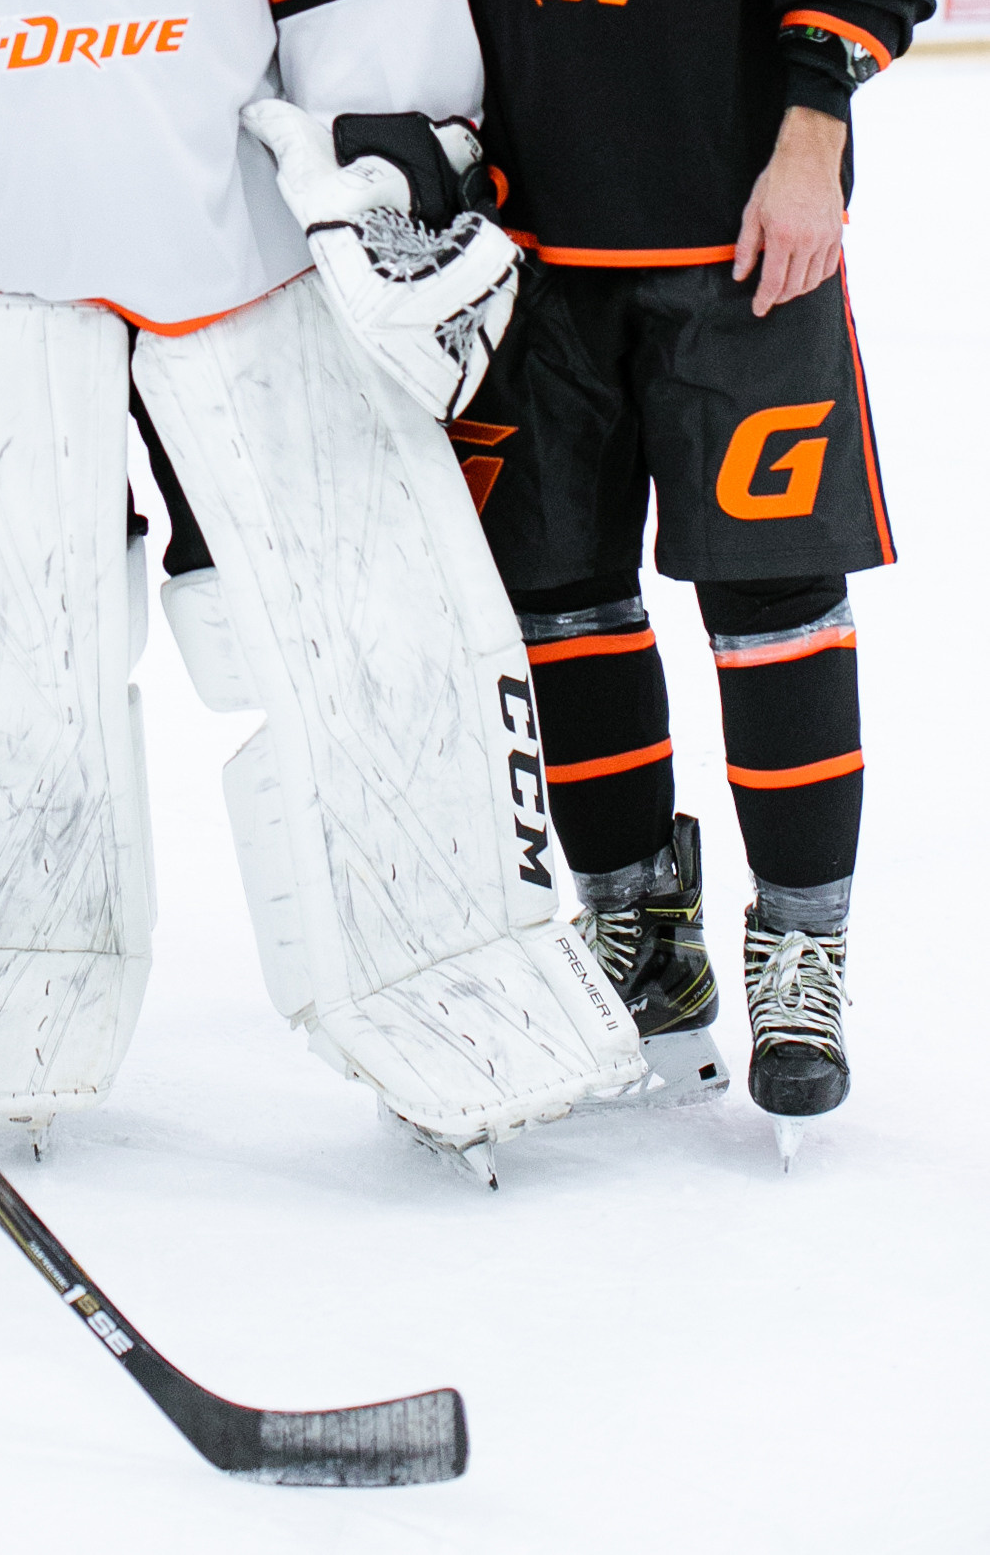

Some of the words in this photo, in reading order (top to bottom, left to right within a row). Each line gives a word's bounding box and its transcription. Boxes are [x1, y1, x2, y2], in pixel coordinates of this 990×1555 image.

[716, 399, 836, 521] G
[497, 673, 553, 891] CCM
[555, 936, 612, 1021] PREMIER
